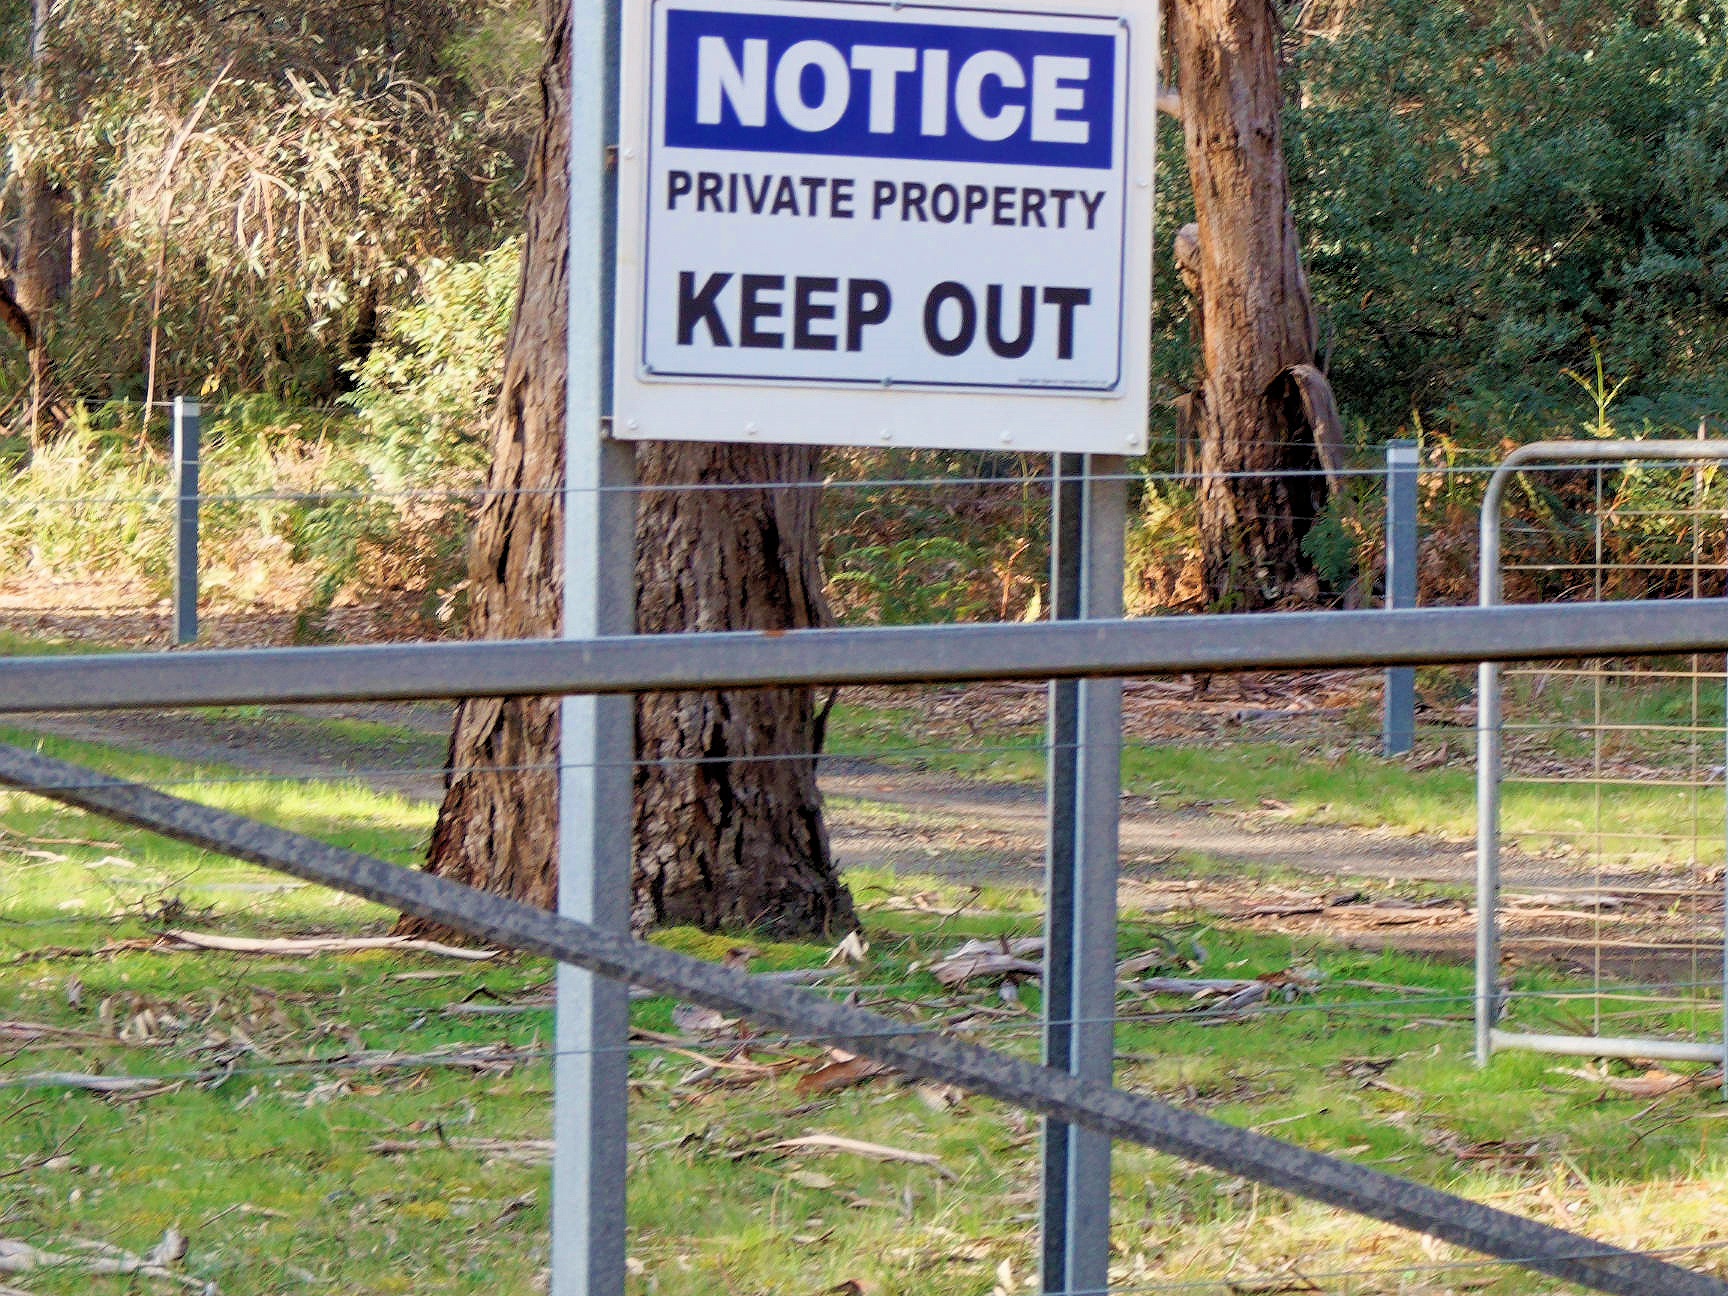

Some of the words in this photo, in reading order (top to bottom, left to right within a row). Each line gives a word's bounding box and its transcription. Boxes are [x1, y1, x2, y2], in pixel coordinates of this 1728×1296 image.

[696, 35, 1090, 145] NOTICE
[667, 169, 855, 219] PRIVATE
[872, 180, 1106, 230] PROPERTY
[676, 270, 893, 353] KEEP
[923, 280, 1092, 360] OUT
